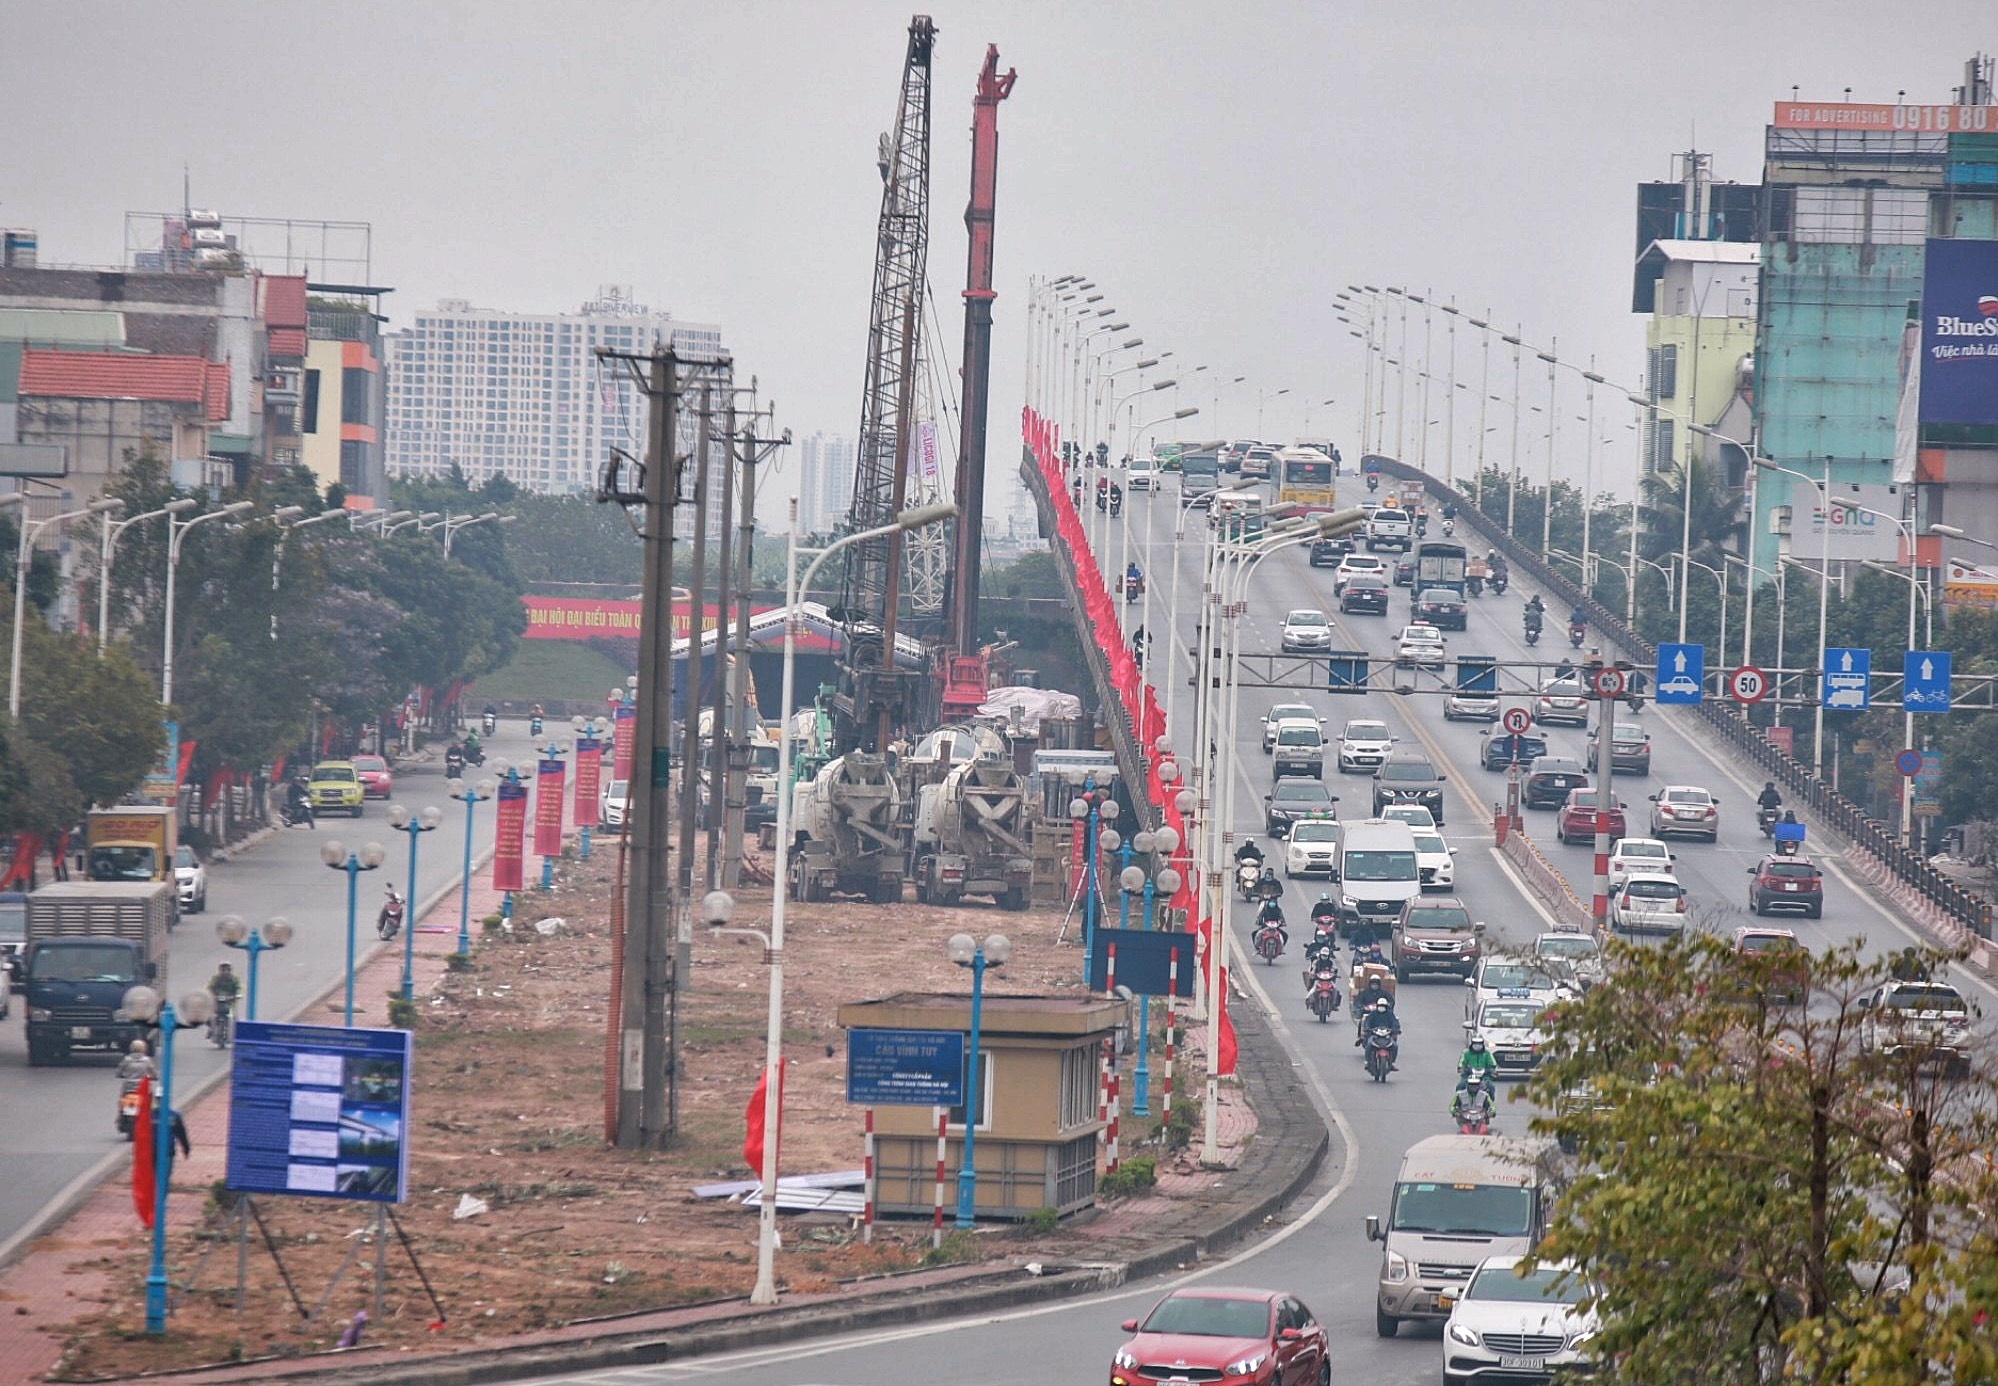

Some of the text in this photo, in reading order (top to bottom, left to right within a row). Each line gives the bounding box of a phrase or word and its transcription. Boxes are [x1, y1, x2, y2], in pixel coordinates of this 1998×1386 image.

[1790, 105, 1987, 130] FOR ADVERTISING 0916 80
[1932, 345, 1959, 358] Việc
[1961, 344, 1984, 356] nhà
[1740, 677, 1757, 693] 50
